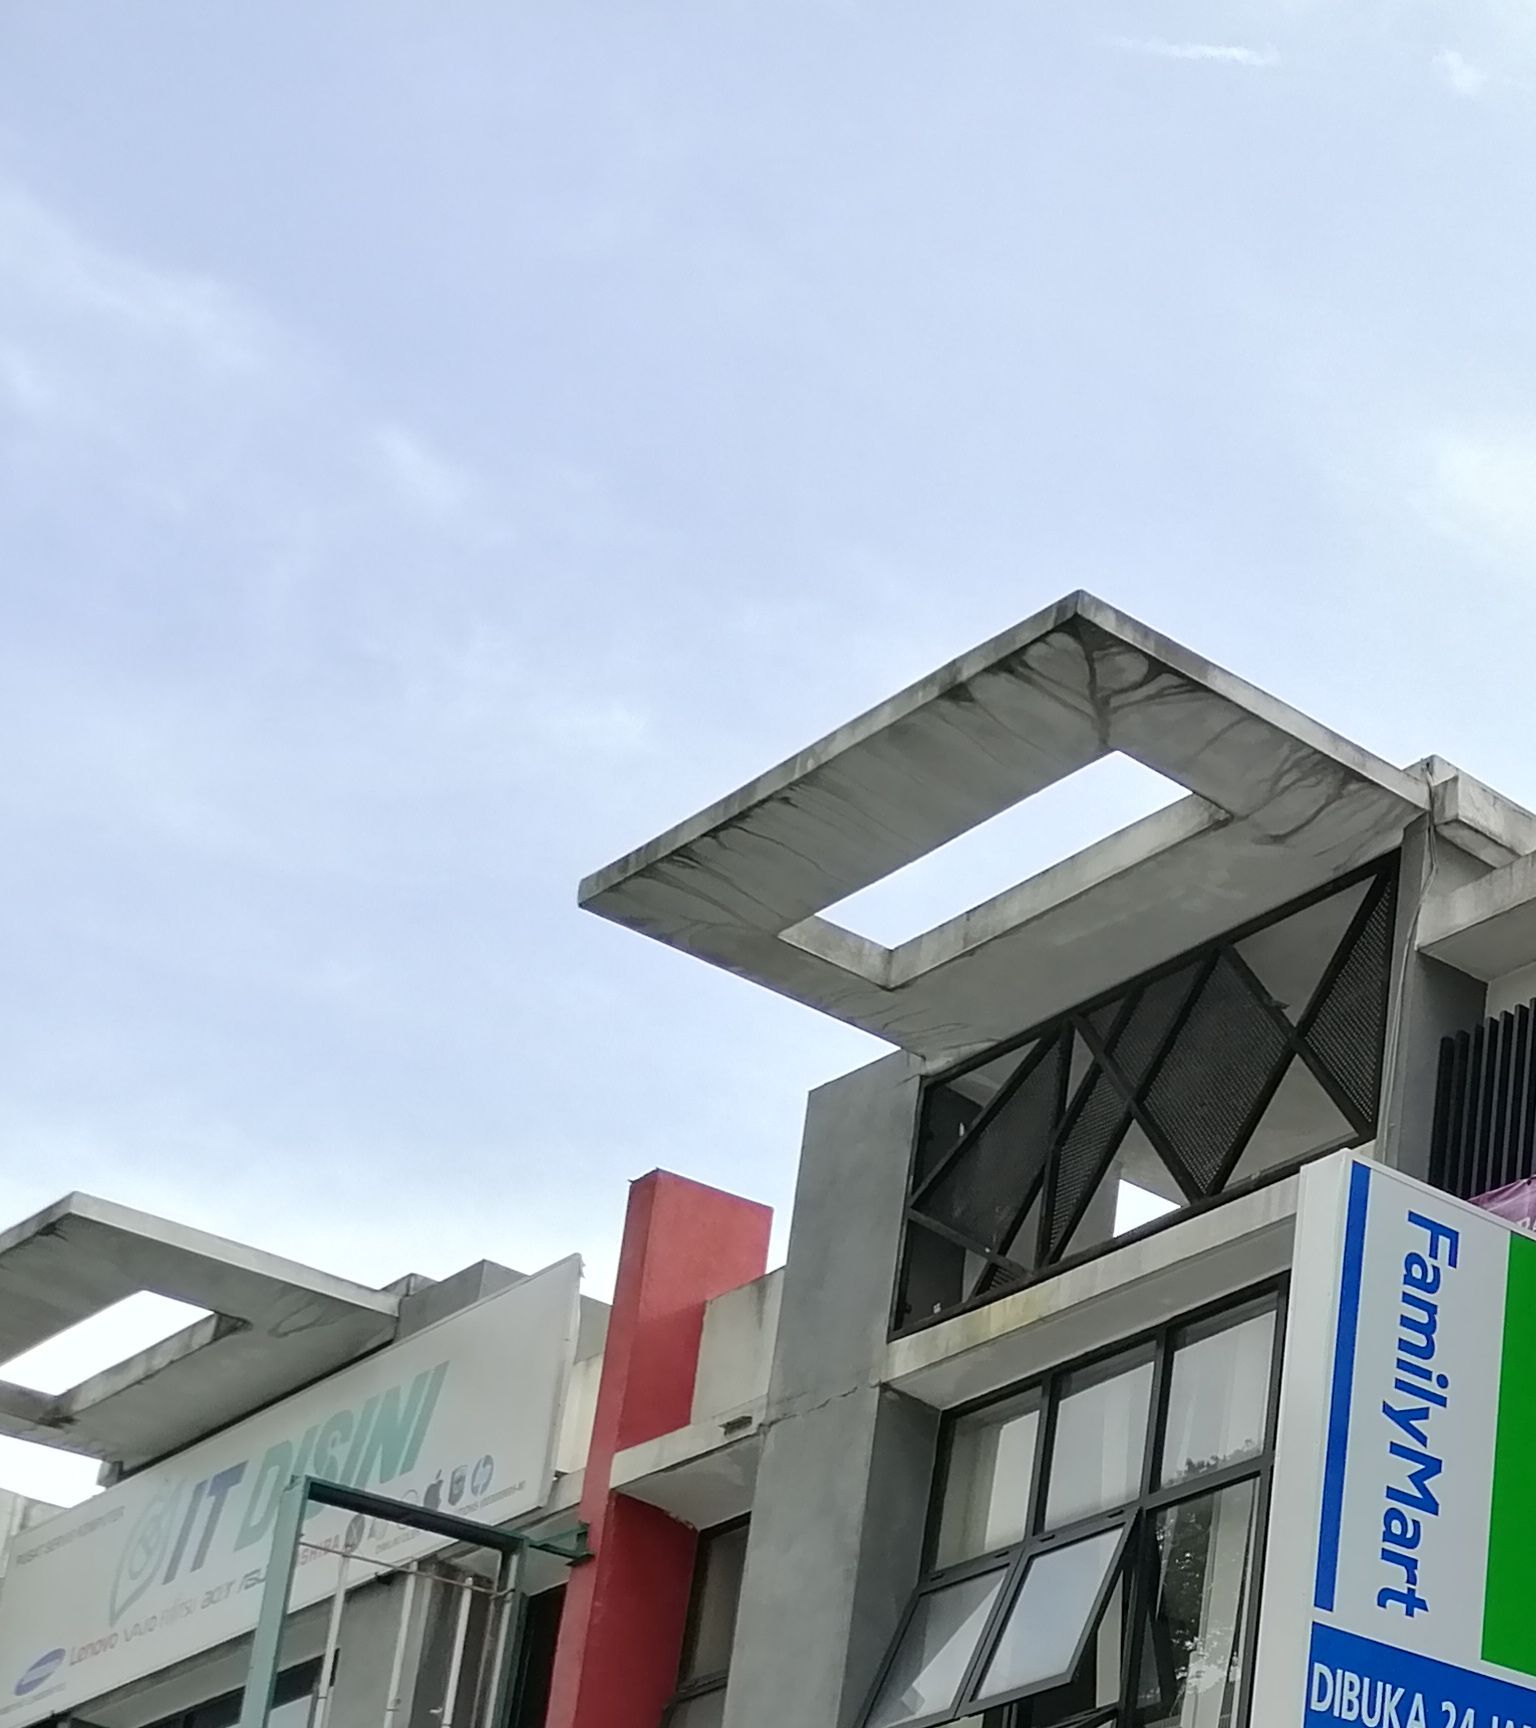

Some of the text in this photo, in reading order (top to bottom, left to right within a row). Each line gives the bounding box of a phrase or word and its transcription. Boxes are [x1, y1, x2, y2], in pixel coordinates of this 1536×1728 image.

[163, 1360, 449, 1585] IT DISINI
[1375, 1209, 1460, 1619] FamilyMart
